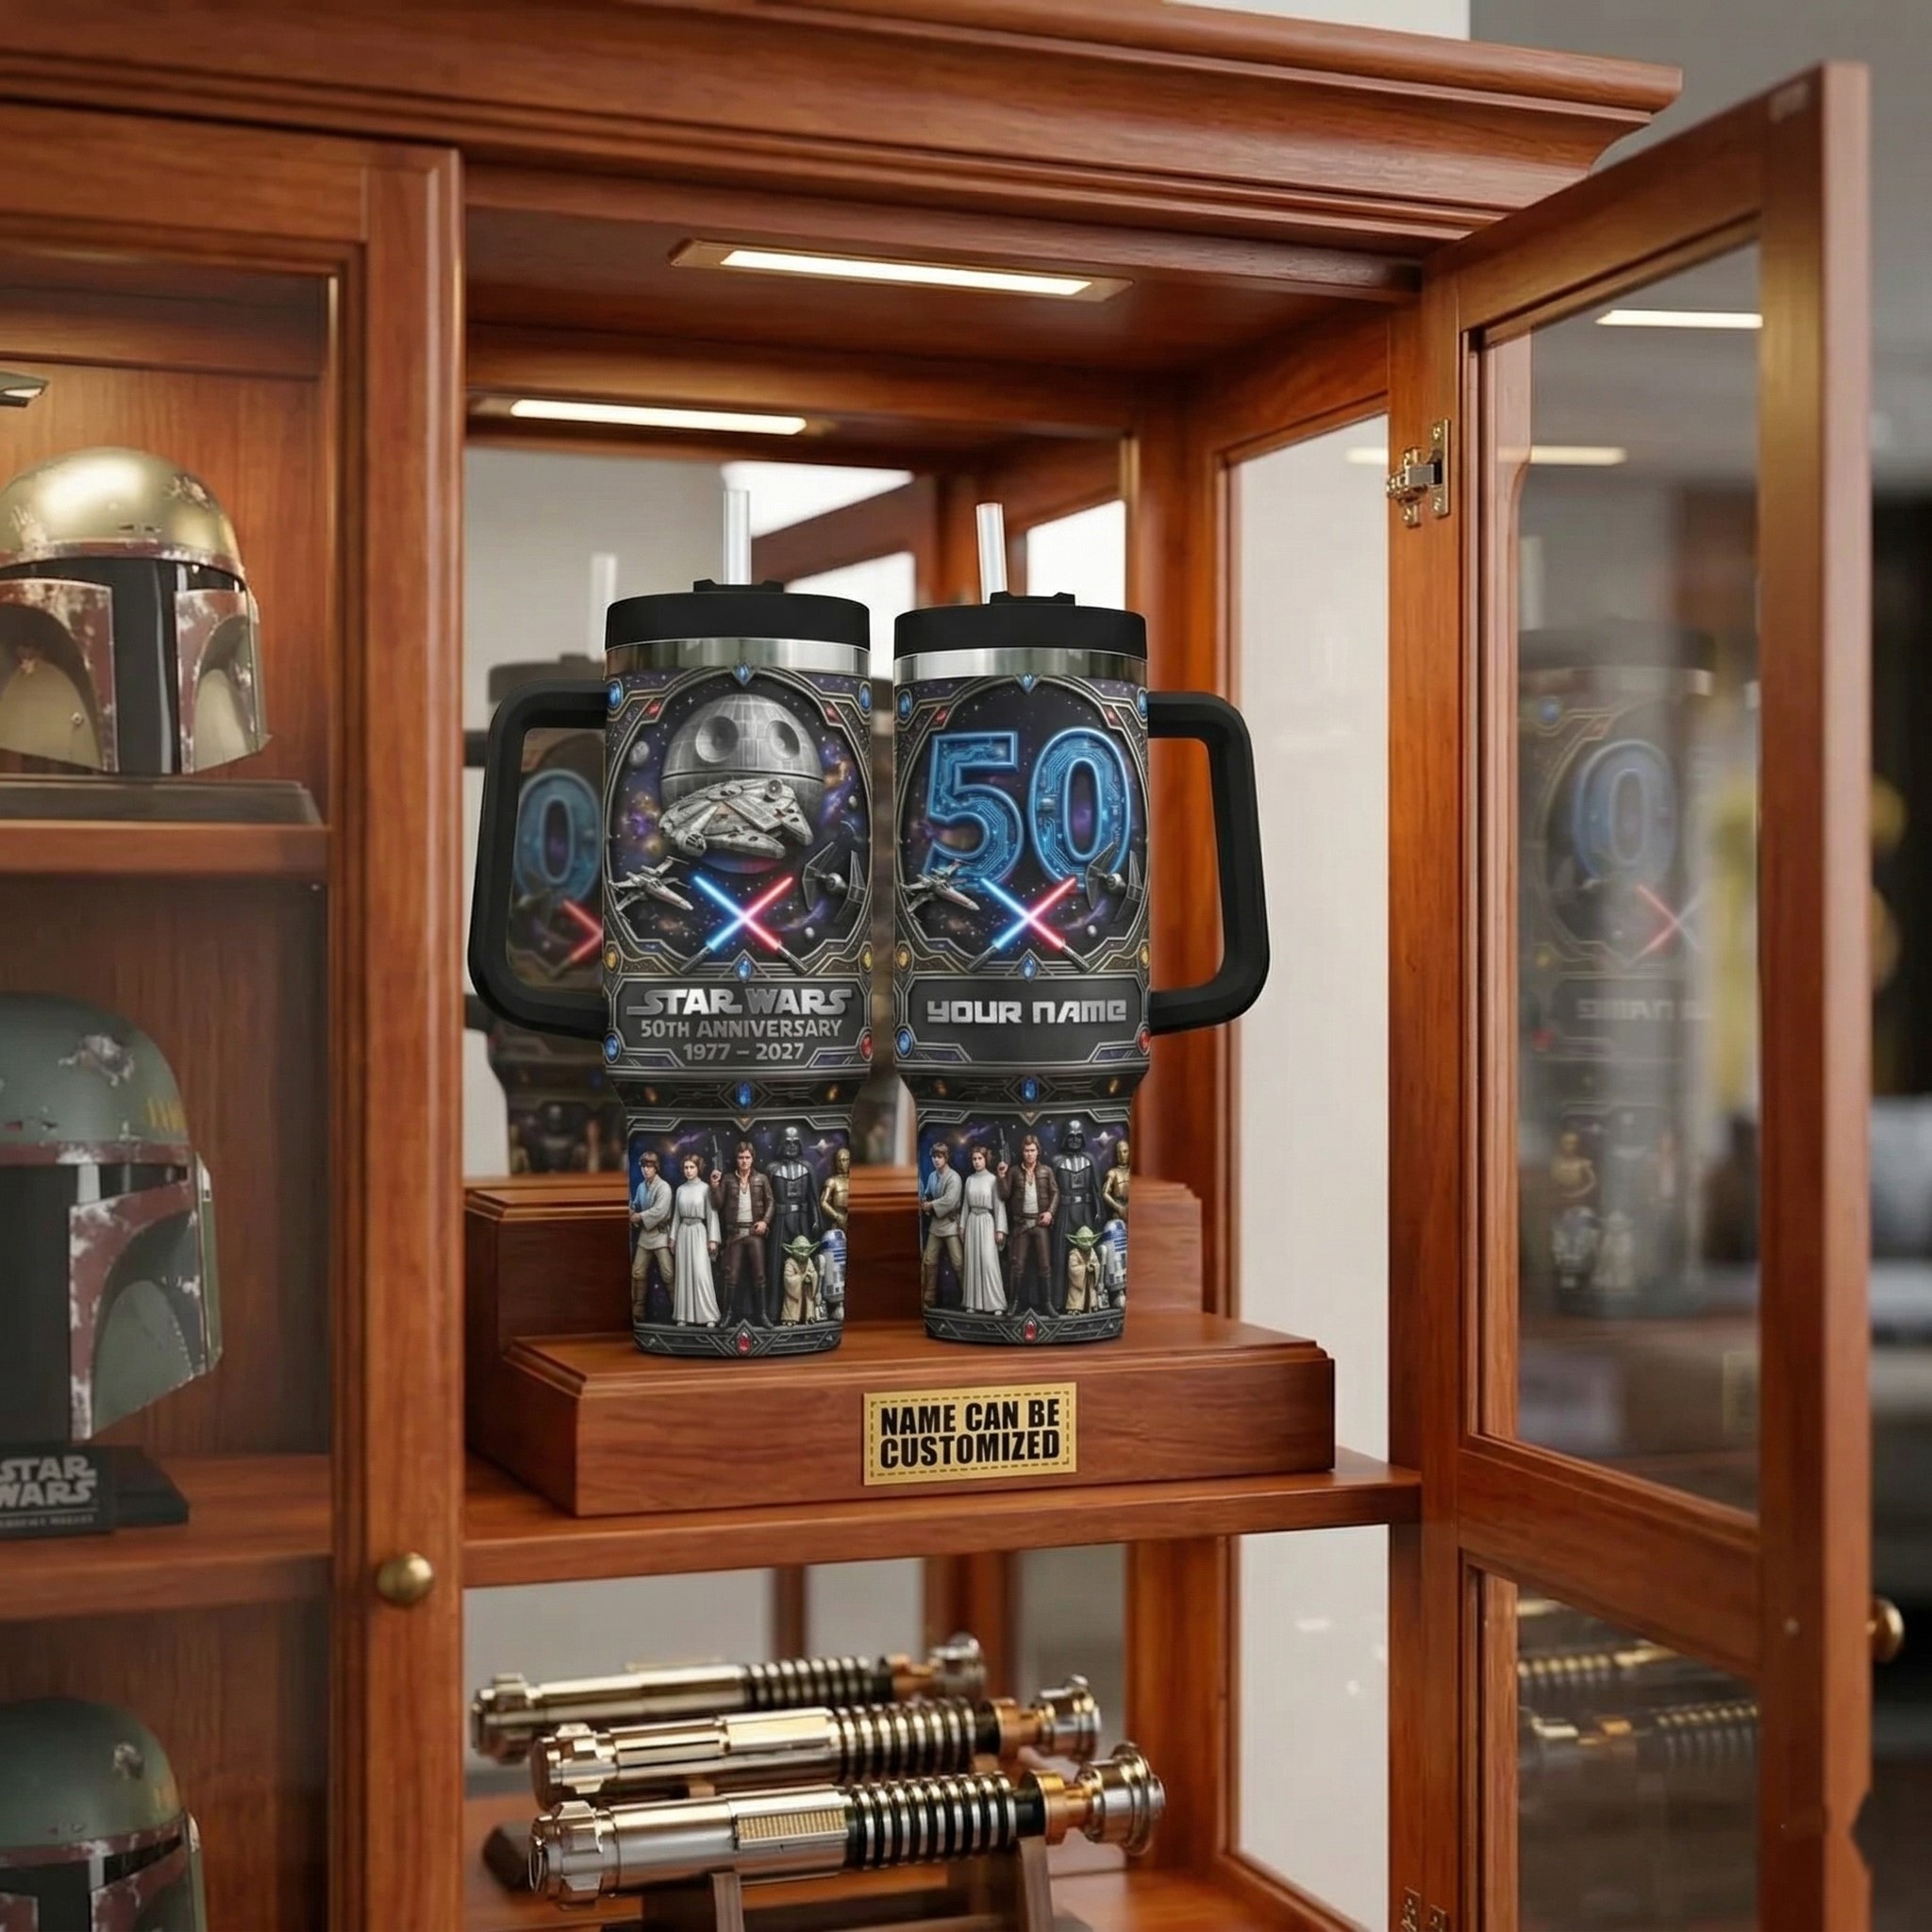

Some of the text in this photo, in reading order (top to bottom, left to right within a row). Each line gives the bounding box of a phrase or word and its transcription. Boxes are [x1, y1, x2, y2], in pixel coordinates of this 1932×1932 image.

[923, 726, 1130, 889] 50
[626, 989, 852, 1015] STAR WARS
[927, 999, 1127, 1024] YOUR NAME
[641, 1020, 842, 1038] 50TH ANNIVERSARY
[683, 1043, 731, 1060] 1977
[756, 1043, 805, 1060] 2027
[880, 1398, 1059, 1436] NAME CAN BE
[880, 1429, 1060, 1469] CUSTOMIZED
[0, 1455, 97, 1482] STAR
